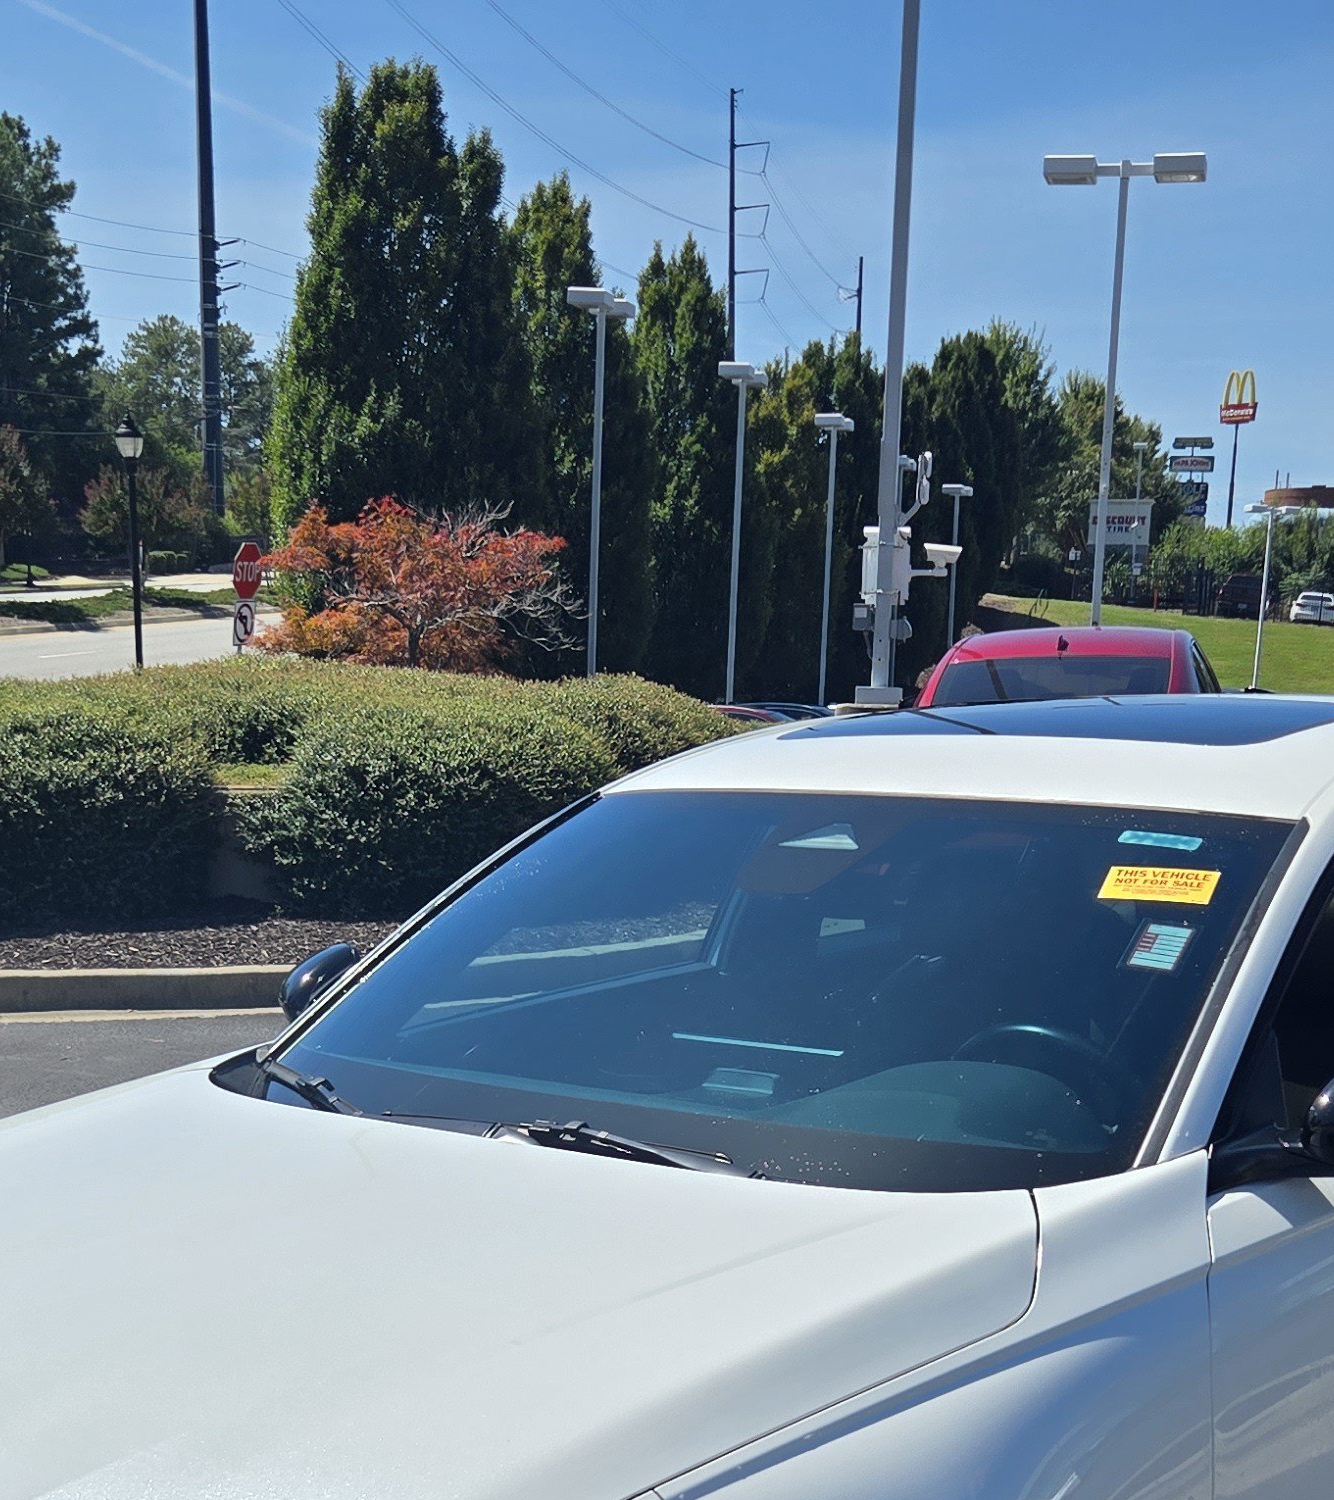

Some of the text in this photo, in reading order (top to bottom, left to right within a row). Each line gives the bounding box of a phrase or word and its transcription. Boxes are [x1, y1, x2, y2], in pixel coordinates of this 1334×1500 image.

[1092, 515, 1146, 526] DSCOUNT
[235, 562, 261, 582] STOP
[1116, 869, 1213, 882] THIS VEHICLE
[1114, 877, 1138, 885] NOT
[1142, 878, 1169, 886] FOR
[1173, 880, 1205, 889] SALE
